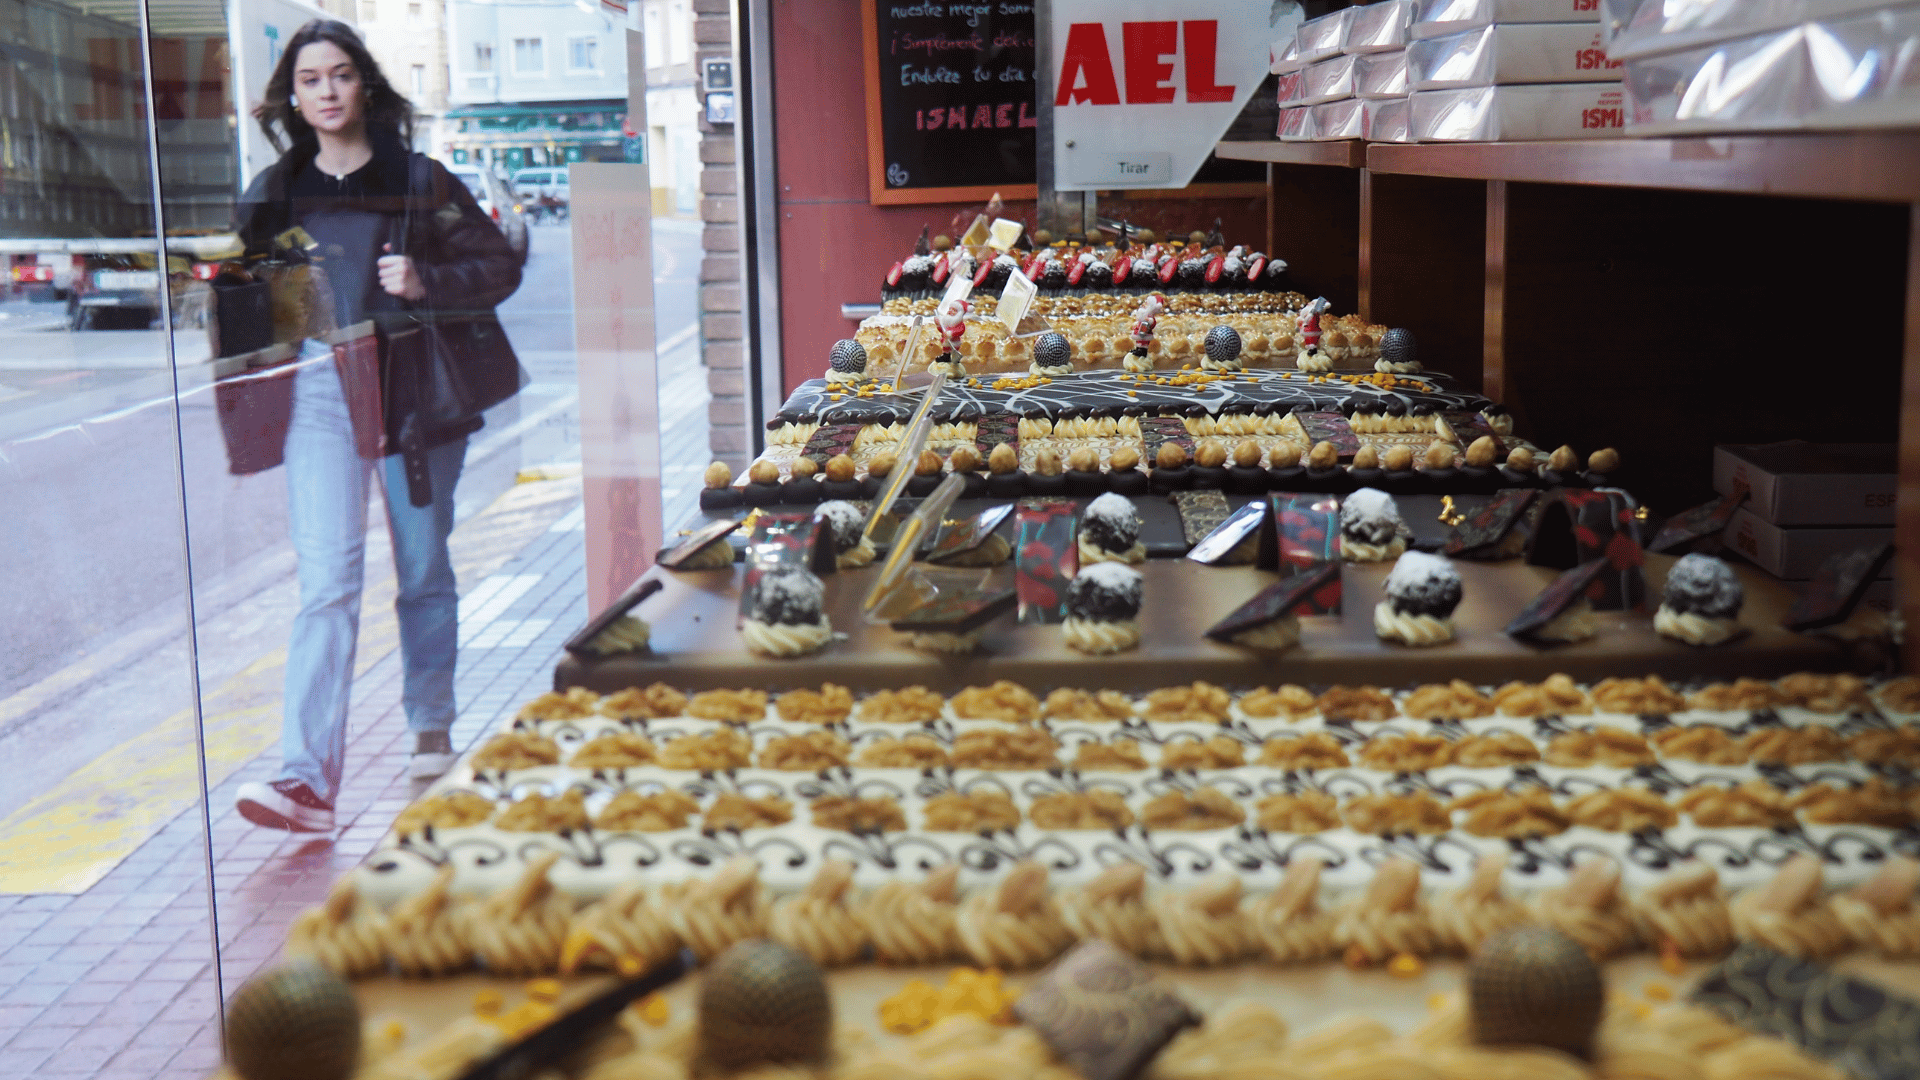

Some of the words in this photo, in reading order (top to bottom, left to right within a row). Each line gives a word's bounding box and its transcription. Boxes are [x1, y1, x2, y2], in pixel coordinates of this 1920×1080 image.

[948, 2, 992, 27] mejor
[972, 65, 992, 82] tu
[1054, 19, 1236, 106] AEL
[915, 101, 1038, 131] ISMAEL
[1117, 161, 1150, 174] Tirar
